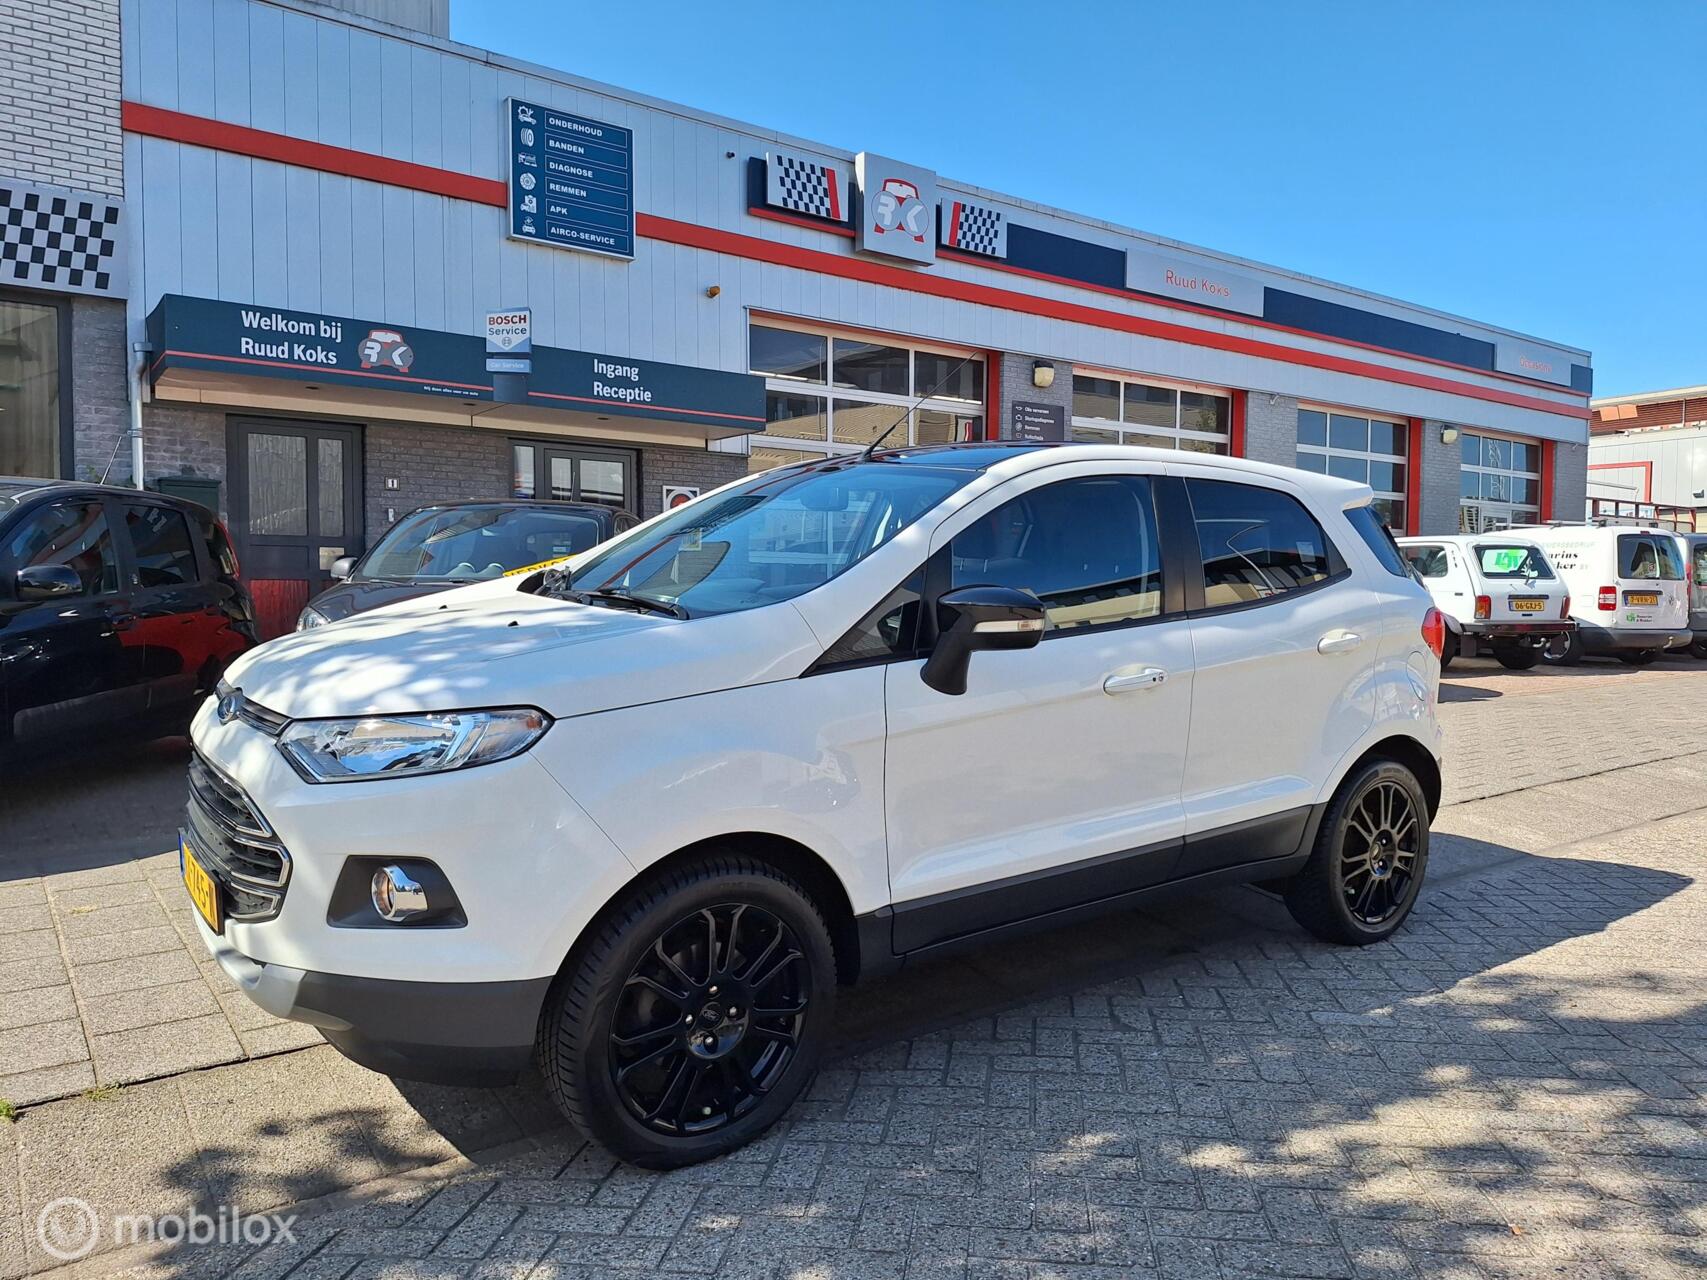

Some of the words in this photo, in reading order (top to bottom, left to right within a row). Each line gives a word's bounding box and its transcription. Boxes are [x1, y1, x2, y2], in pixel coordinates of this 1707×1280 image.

[549, 118, 602, 136] ONDERHOUD
[549, 140, 584, 154] BANDEN
[549, 162, 593, 178] DIAGNOSE
[550, 183, 587, 197] REMMEN
[550, 205, 568, 215] APK
[551, 227, 615, 245] AIRCO-SERVICE
[1166, 269, 1197, 289] Ruud
[1201, 279, 1230, 297] Koks
[241, 310, 316, 336] Welkom
[320, 320, 342, 343] bij
[488, 314, 527, 325] BOSCH
[488, 326, 527, 335] Service
[240, 337, 288, 359] Ruud
[293, 343, 337, 365] Koks
[594, 358, 639, 381] Ingang
[593, 381, 652, 403] Receptie
